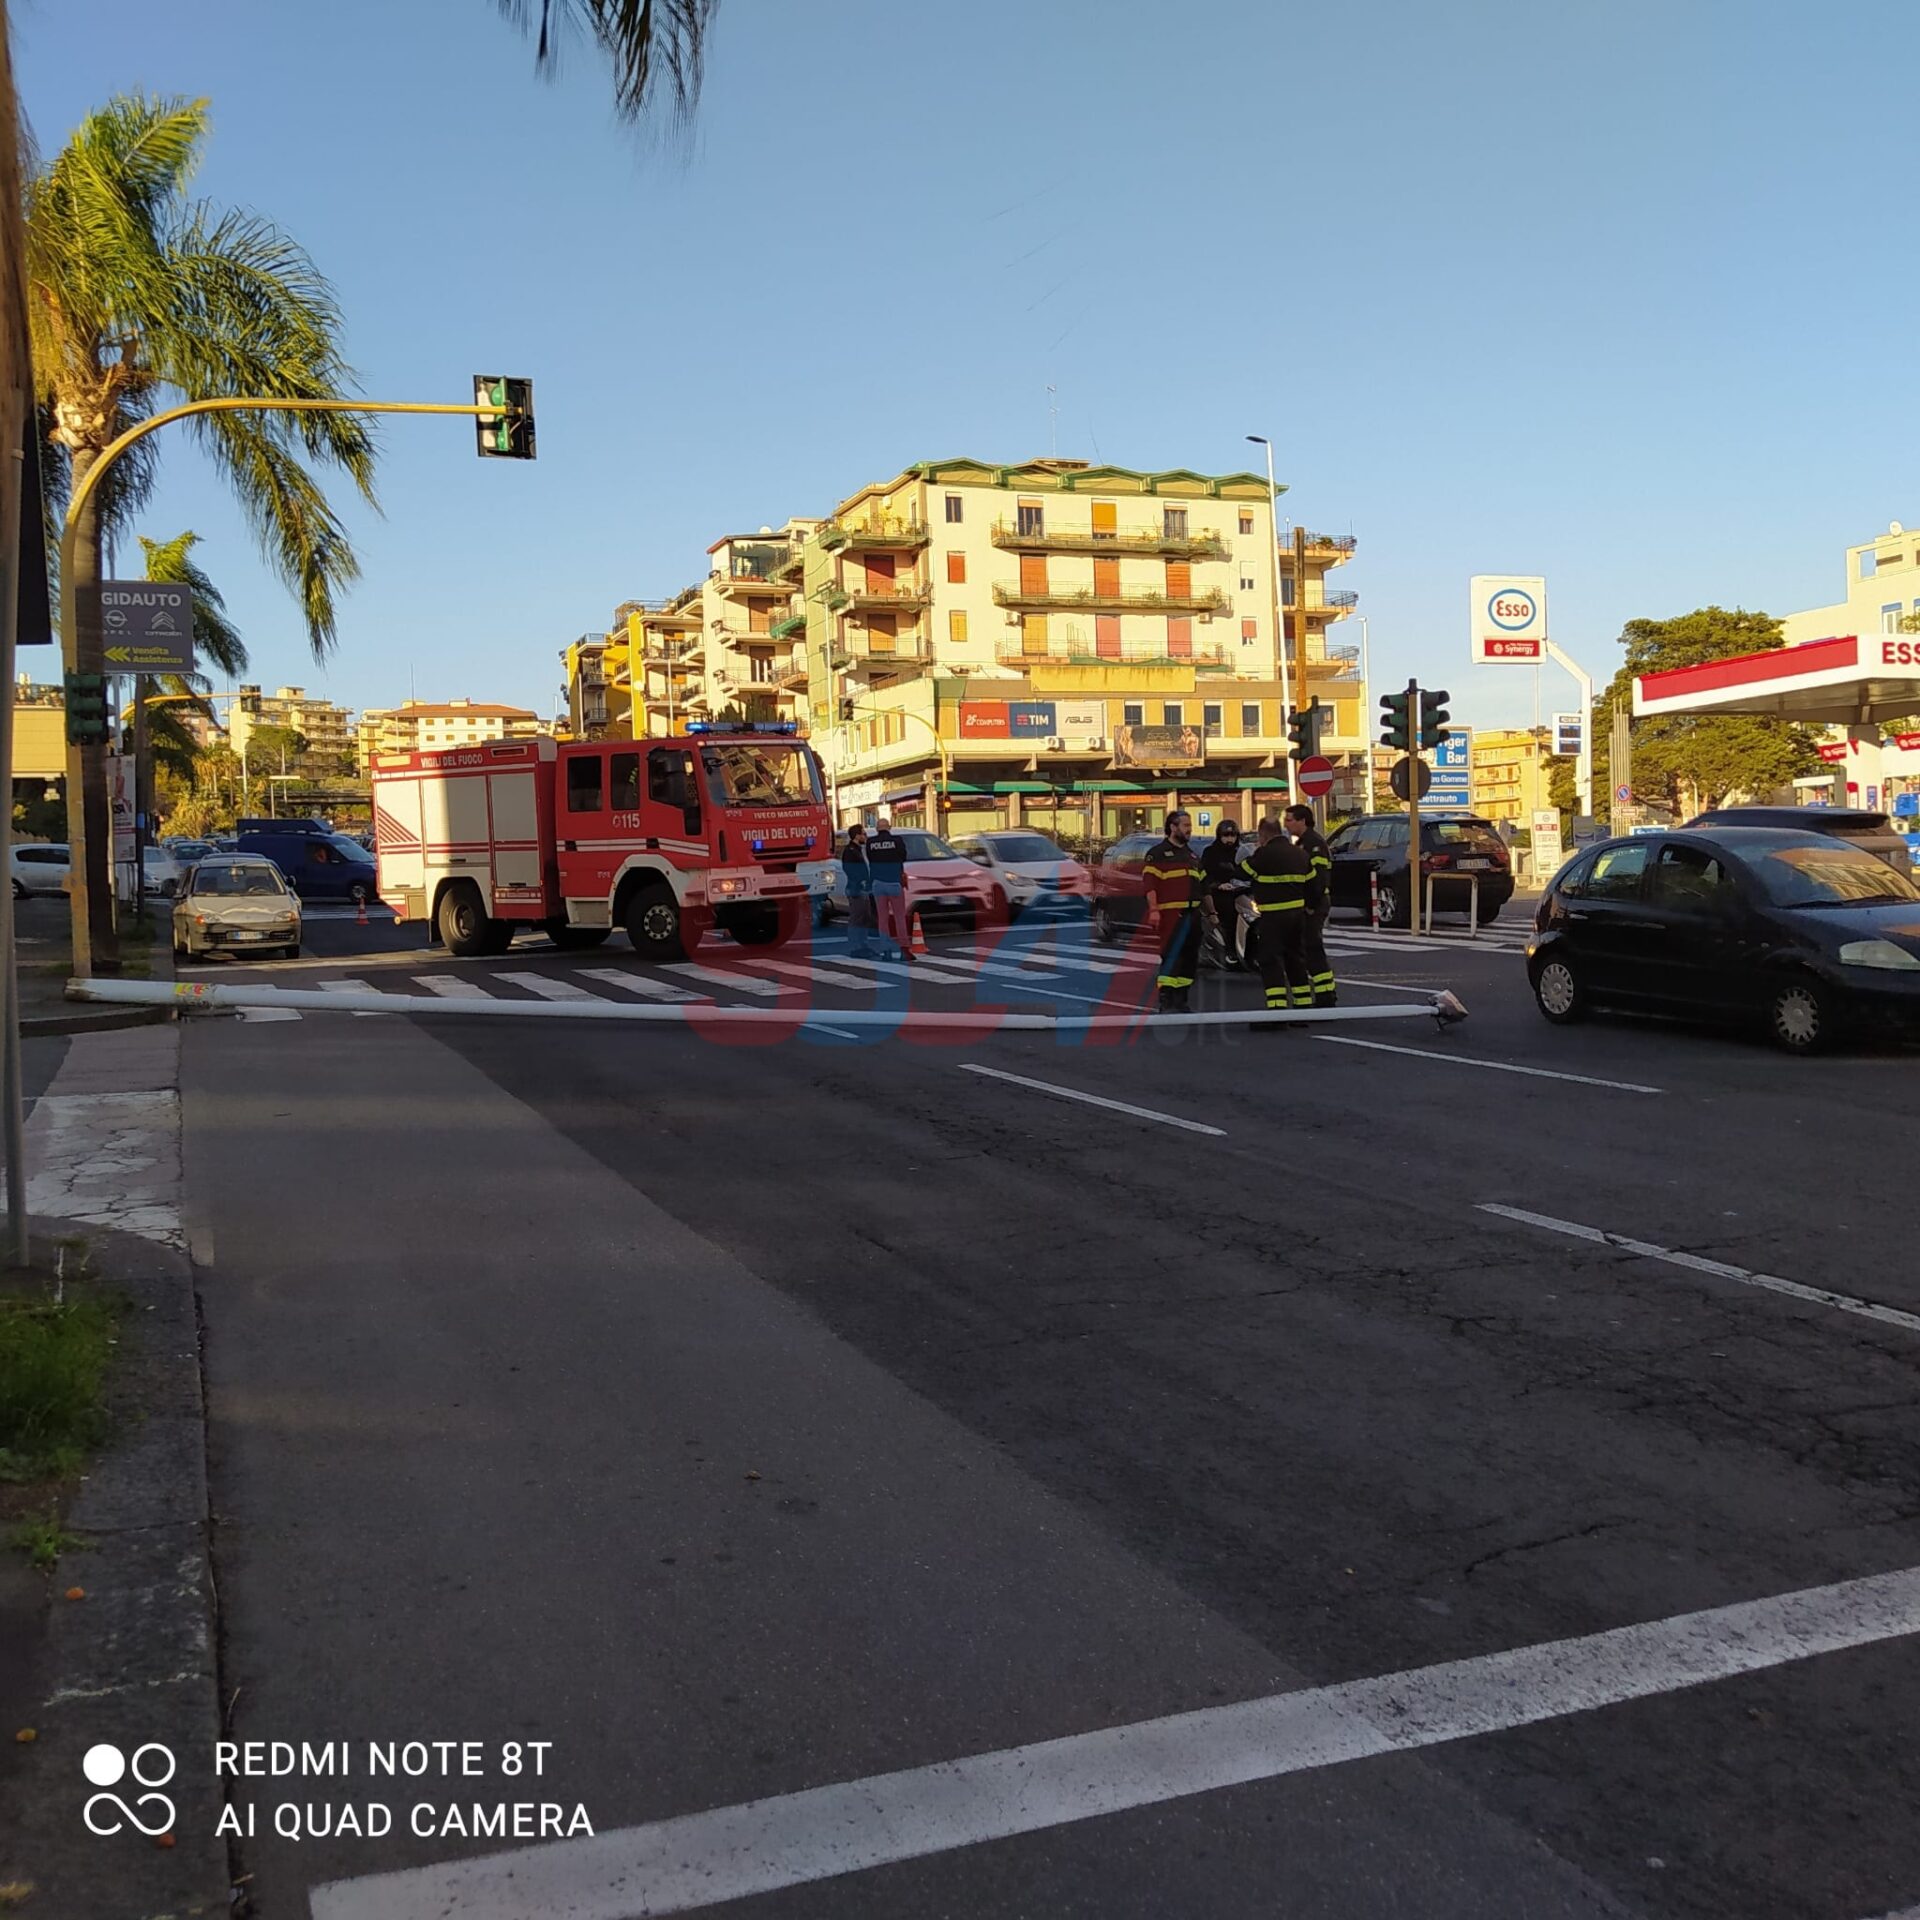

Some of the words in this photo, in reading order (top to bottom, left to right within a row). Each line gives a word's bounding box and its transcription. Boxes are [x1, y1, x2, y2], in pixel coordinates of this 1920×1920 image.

[101, 592, 181, 606] GIDAUTO
[1496, 600, 1529, 617] Esso
[132, 647, 169, 655] Vendita
[1504, 644, 1534, 655] Synergy
[132, 656, 183, 664] Assistenza
[1028, 714, 1049, 726] TIM
[1065, 716, 1093, 724] ASUS
[420, 756, 442, 768] VIGILI
[442, 755, 457, 767] DEL
[458, 753, 483, 766] FUOCO
[1446, 751, 1466, 764] Bar
[1440, 774, 1468, 783] Gomme
[621, 813, 640, 828] 115
[754, 811, 776, 820] IVECO
[741, 828, 769, 841] VIGILI
[771, 827, 788, 839] DEL
[790, 826, 818, 838] FUOCO
[870, 841, 896, 850] POLIZIA
